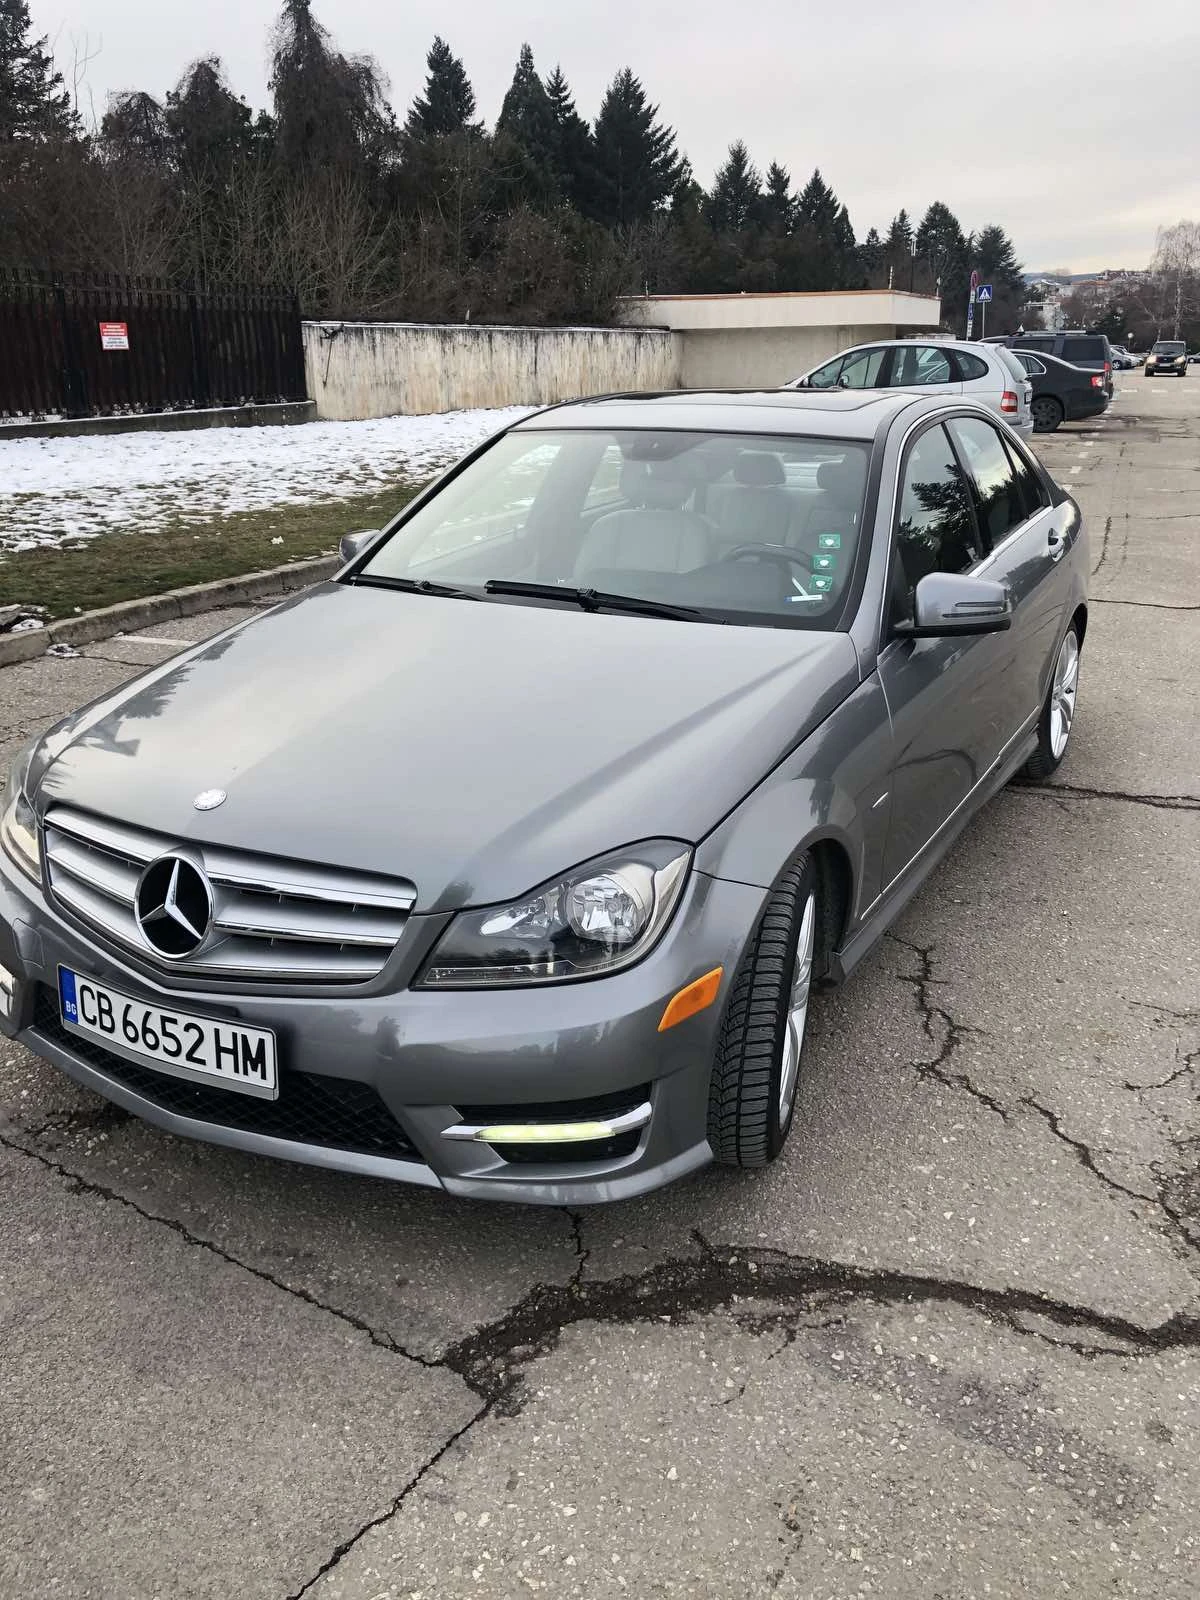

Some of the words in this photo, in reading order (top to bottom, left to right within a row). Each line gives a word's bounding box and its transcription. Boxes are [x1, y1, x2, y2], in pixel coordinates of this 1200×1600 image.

[66, 1000, 77, 1015] BG
[79, 984, 116, 1034] CB
[122, 1003, 207, 1066] 6652
[214, 1027, 267, 1081] HM
